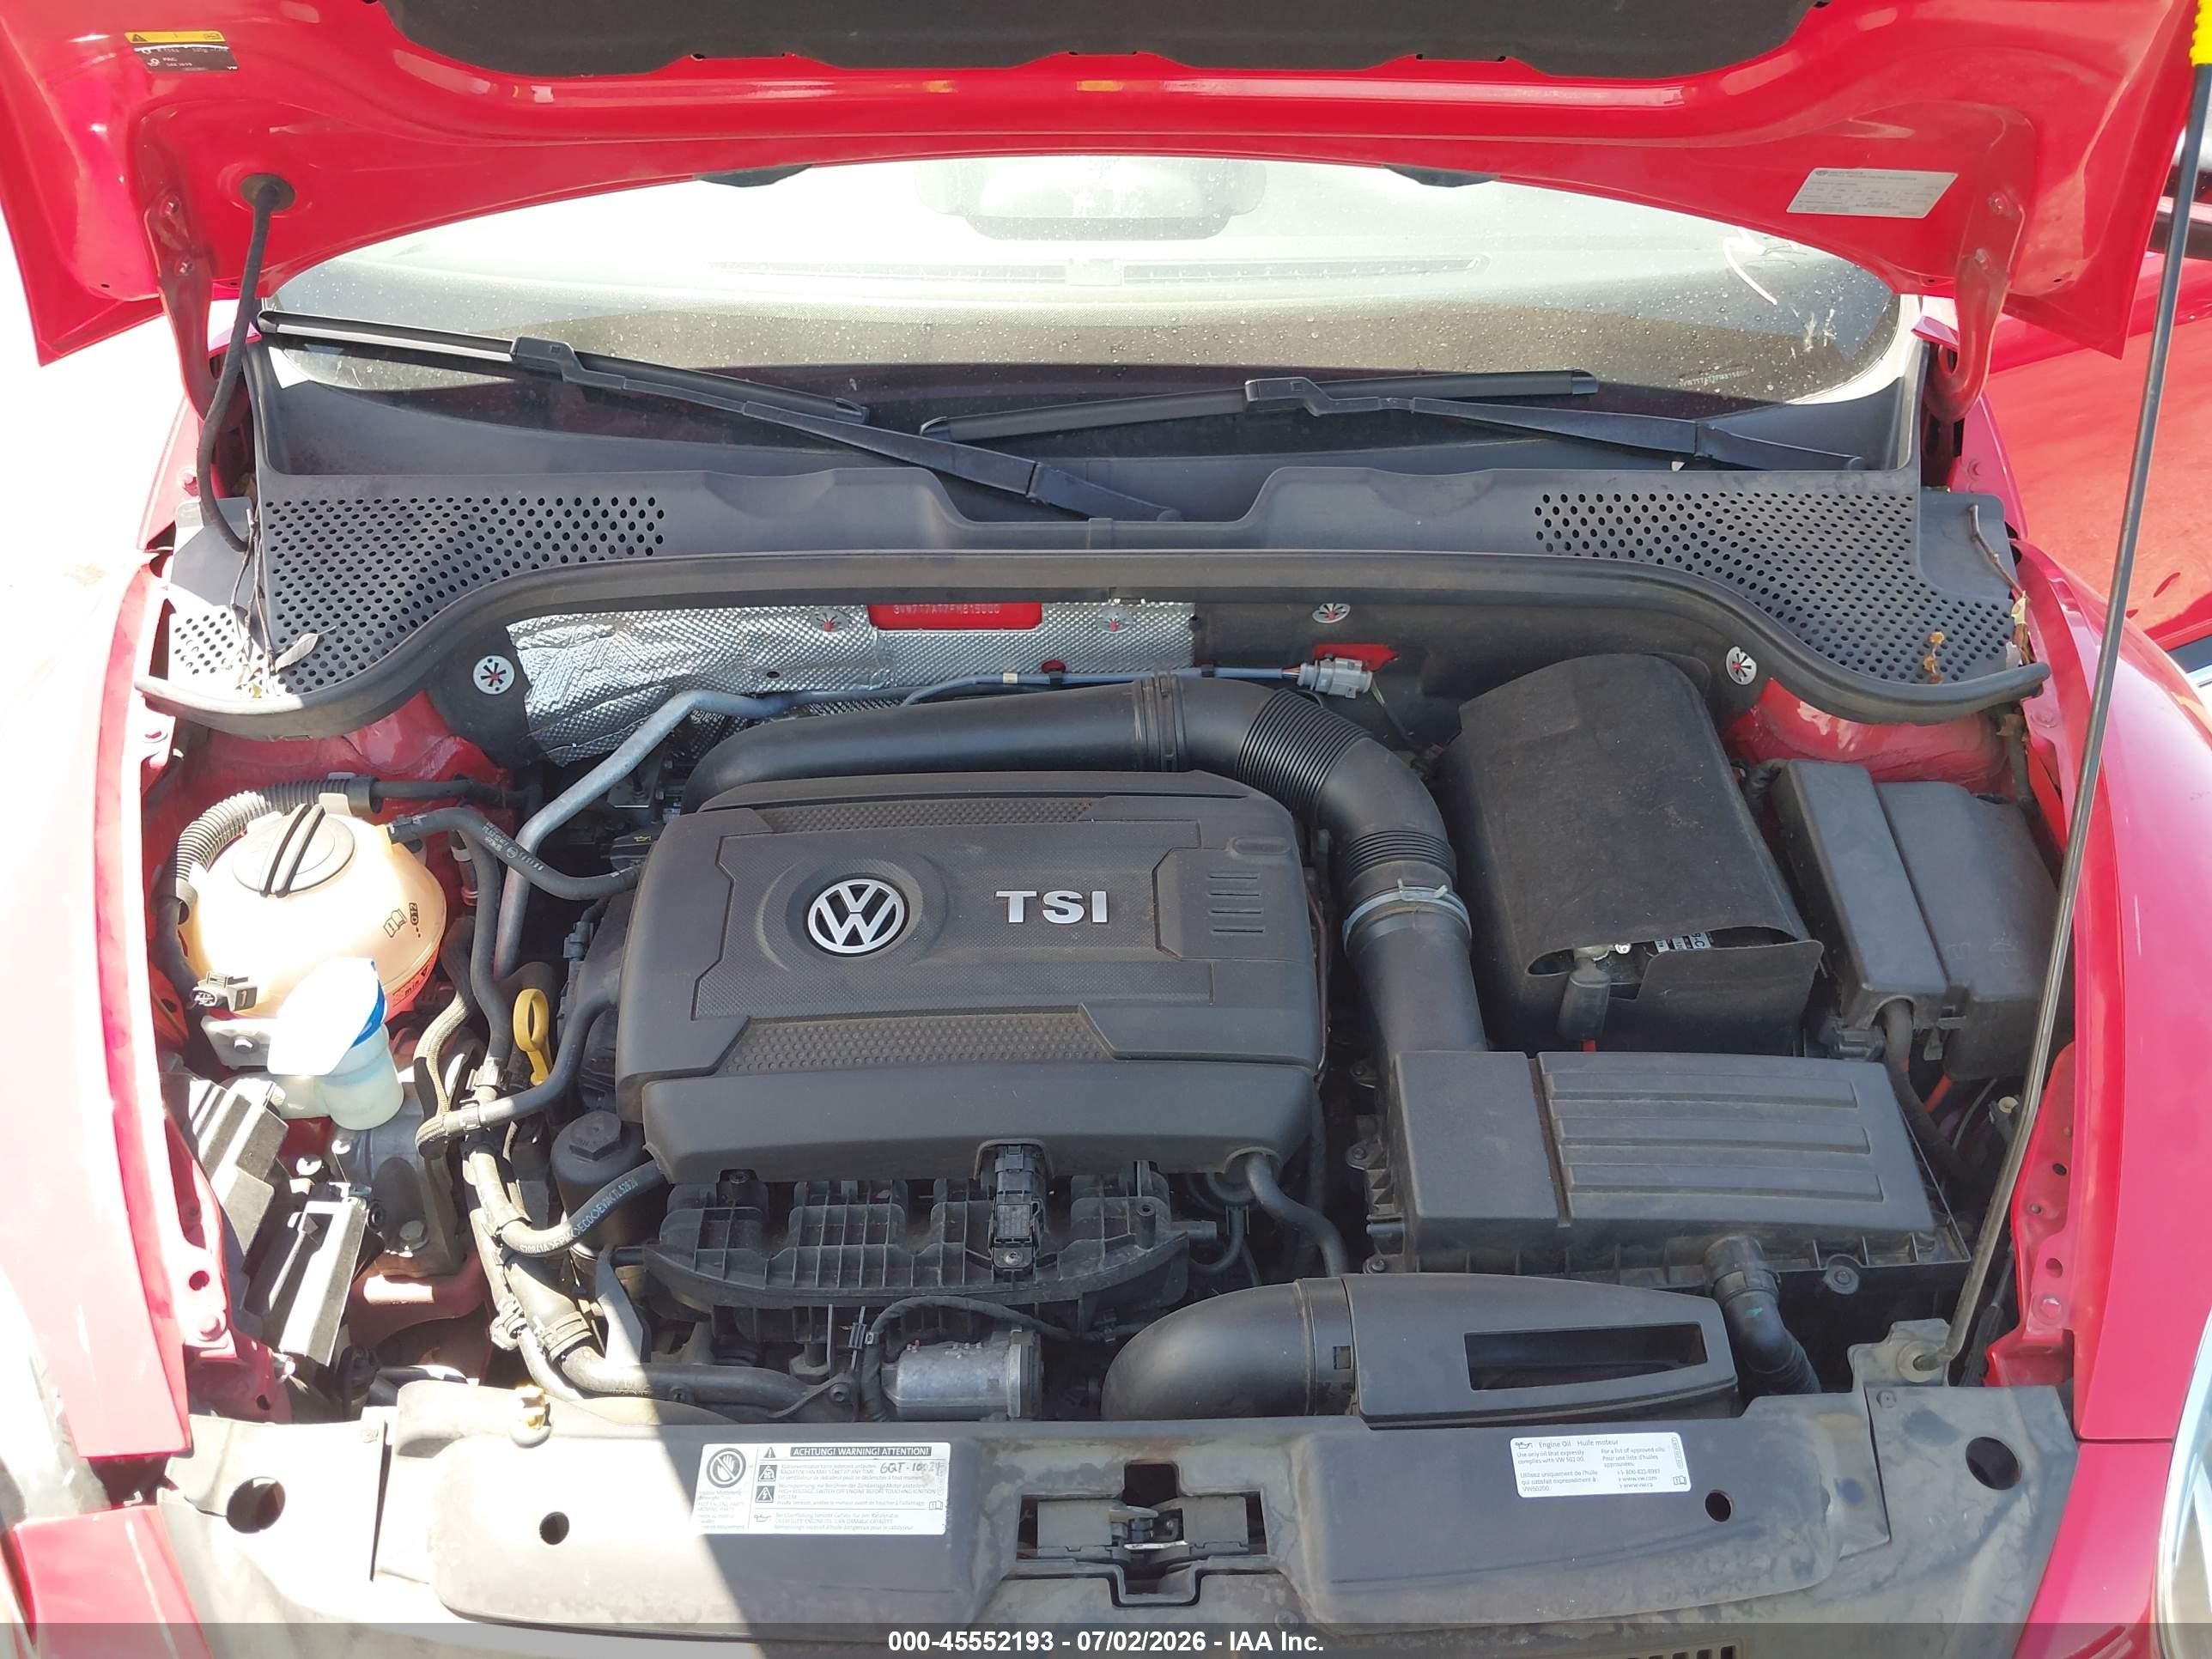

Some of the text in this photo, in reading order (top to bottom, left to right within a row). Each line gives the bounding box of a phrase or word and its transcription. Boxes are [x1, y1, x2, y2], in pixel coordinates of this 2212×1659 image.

[995, 890, 1108, 924] TSI
[404, 981, 420, 996] min
[793, 1447, 928, 1455] ACHTUNG! WARNING! ATTENTION!
